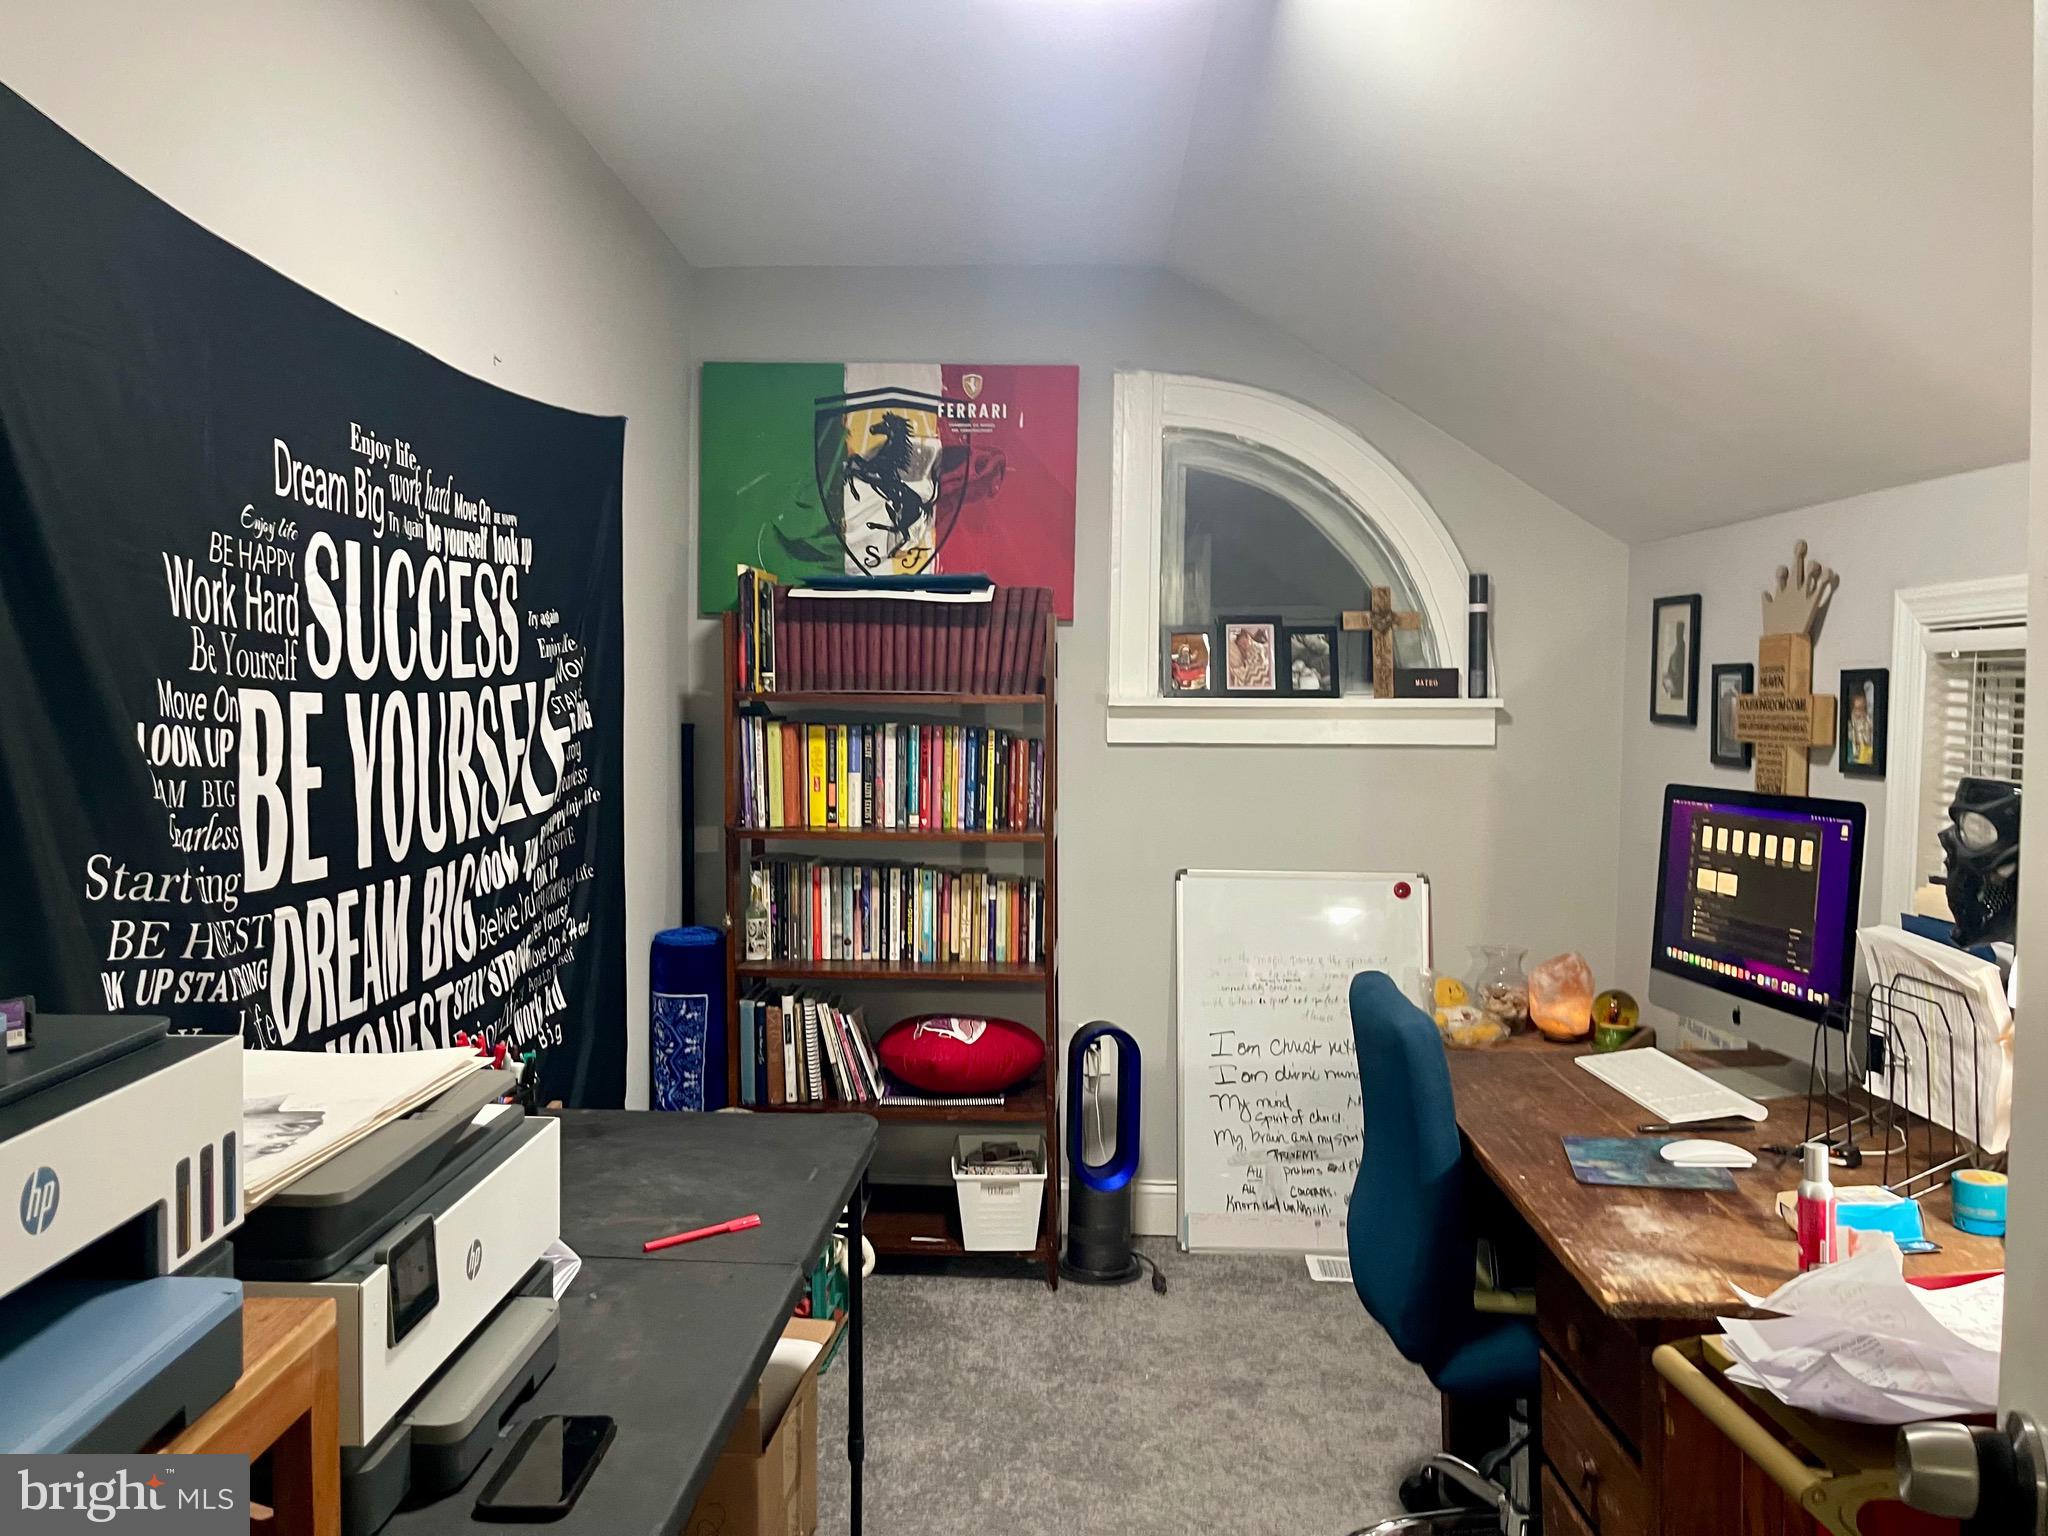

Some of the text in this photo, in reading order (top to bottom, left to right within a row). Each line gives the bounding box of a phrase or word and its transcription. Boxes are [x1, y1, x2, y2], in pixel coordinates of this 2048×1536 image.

[937, 402, 1007, 419] FERRARI
[350, 421, 391, 469] Enjoy
[273, 437, 385, 539] Dream Big
[454, 491, 492, 525] Move On
[240, 503, 299, 542] Enjoy life
[425, 513, 488, 563] be yourself
[208, 531, 295, 579] BE HAPPY
[493, 525, 519, 566] look
[864, 545, 931, 569] S F
[162, 551, 299, 637] Work Hard
[304, 530, 519, 680] SUCCESS
[189, 626, 298, 681] Be Yourself
[157, 678, 239, 722] Move On
[204, 728, 234, 768] UP
[201, 779, 235, 808] BIG
[237, 676, 571, 893] BE YOURSELF
[86, 853, 242, 913] Starting
[107, 920, 170, 961] BE
[270, 853, 477, 1046] DREAM BIG
[136, 968, 175, 1006] UP
[454, 965, 487, 1020] STAY
[1208, 1030, 1236, 1057] I
[1208, 1064, 1238, 1085] I
[24, 1168, 57, 1235] hp
[467, 1240, 481, 1280] hp
